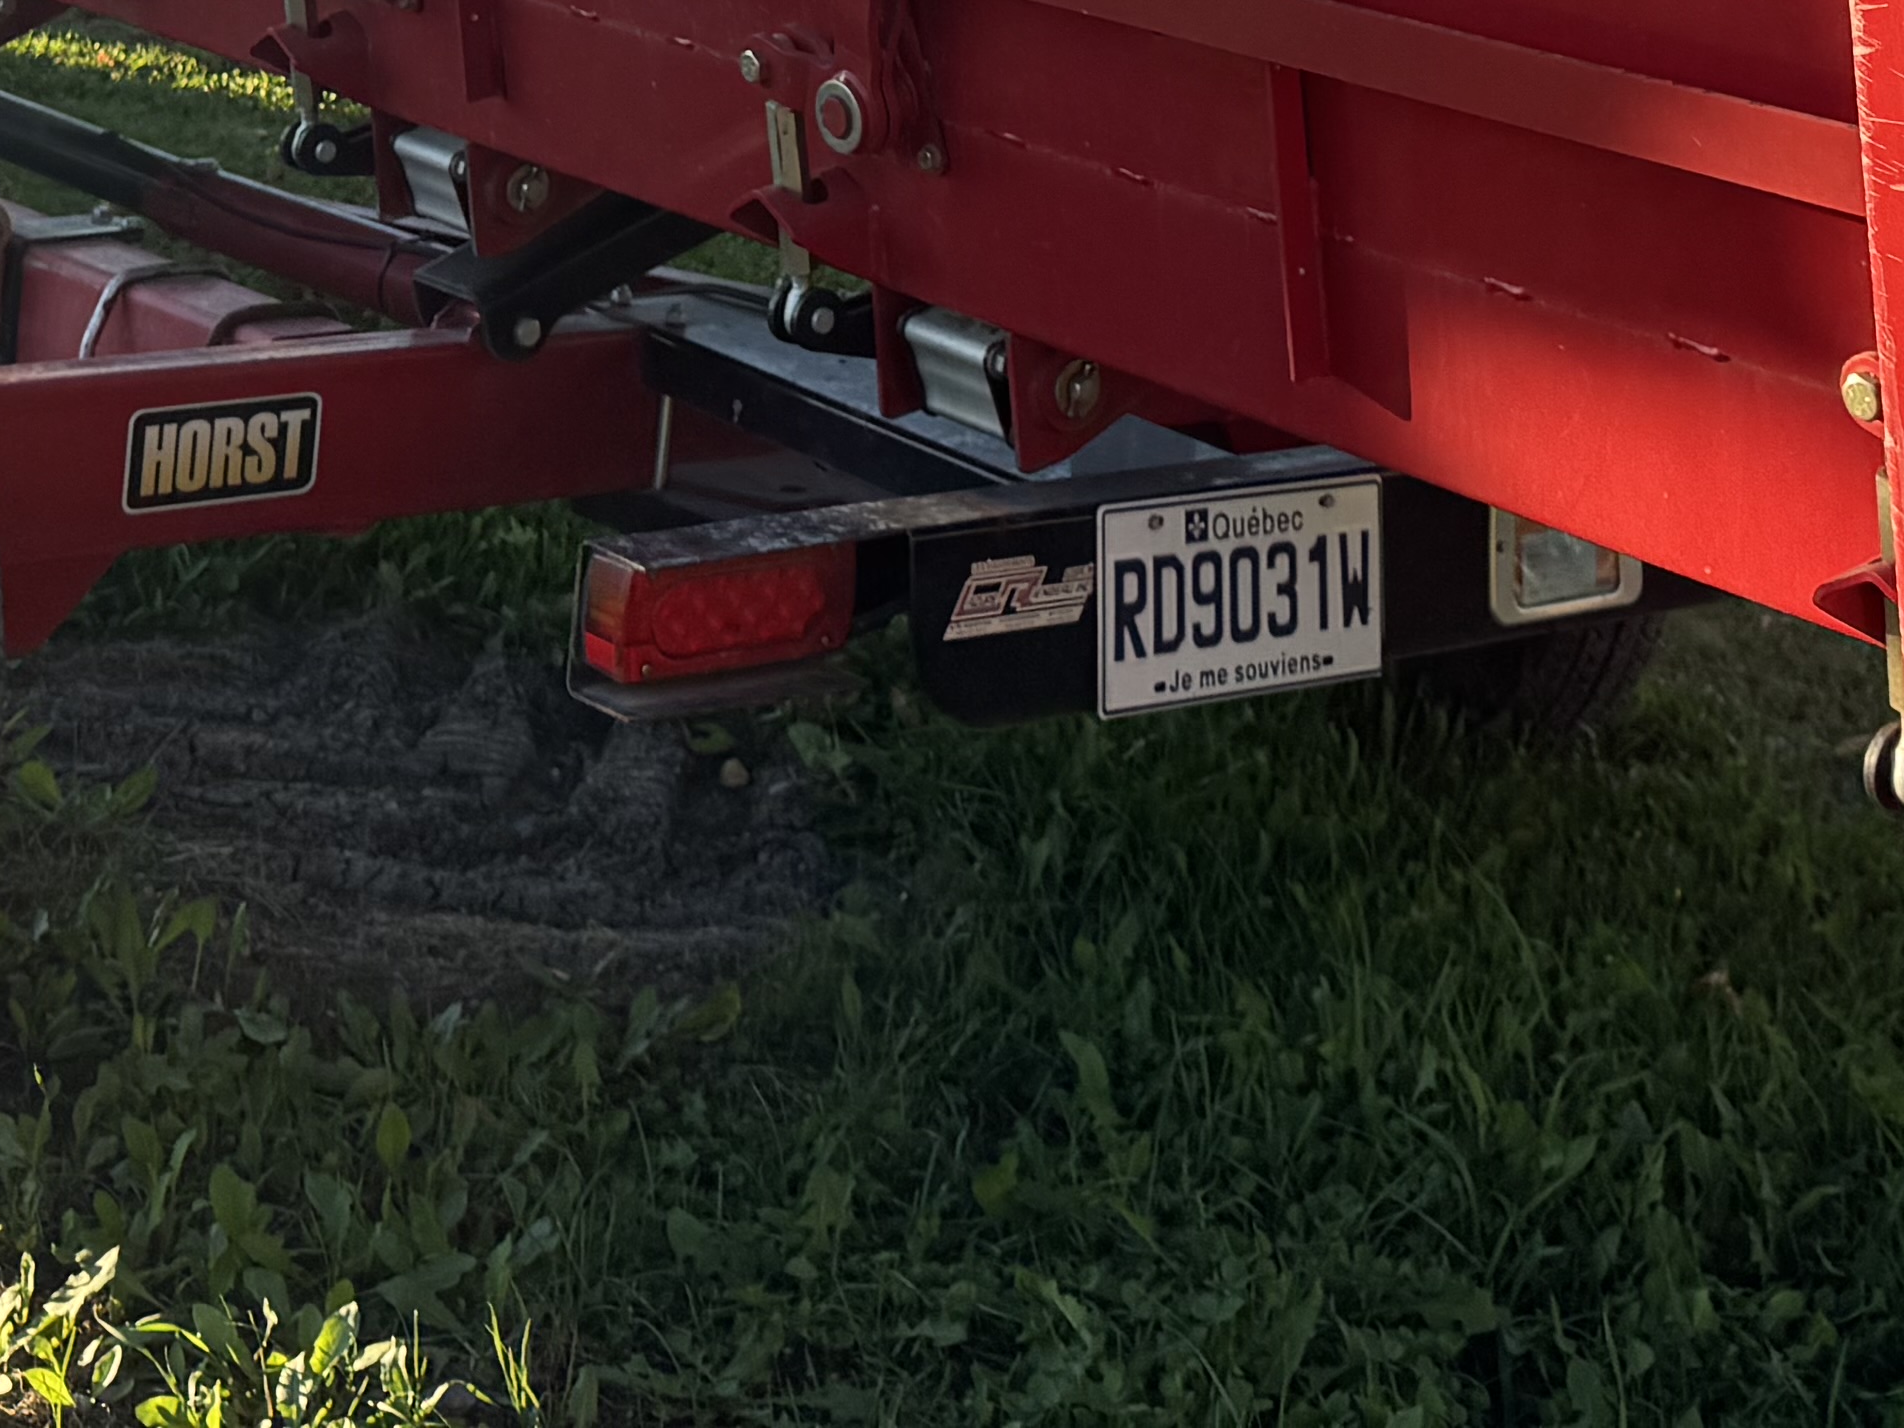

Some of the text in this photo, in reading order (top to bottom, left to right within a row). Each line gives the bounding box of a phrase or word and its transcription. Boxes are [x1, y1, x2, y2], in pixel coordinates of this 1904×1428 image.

[139, 407, 312, 498] HORST
[1212, 505, 1304, 540] Québec
[1113, 529, 1370, 663] RD9031W
[1199, 667, 1228, 689] me
[1234, 651, 1322, 683] souviens
